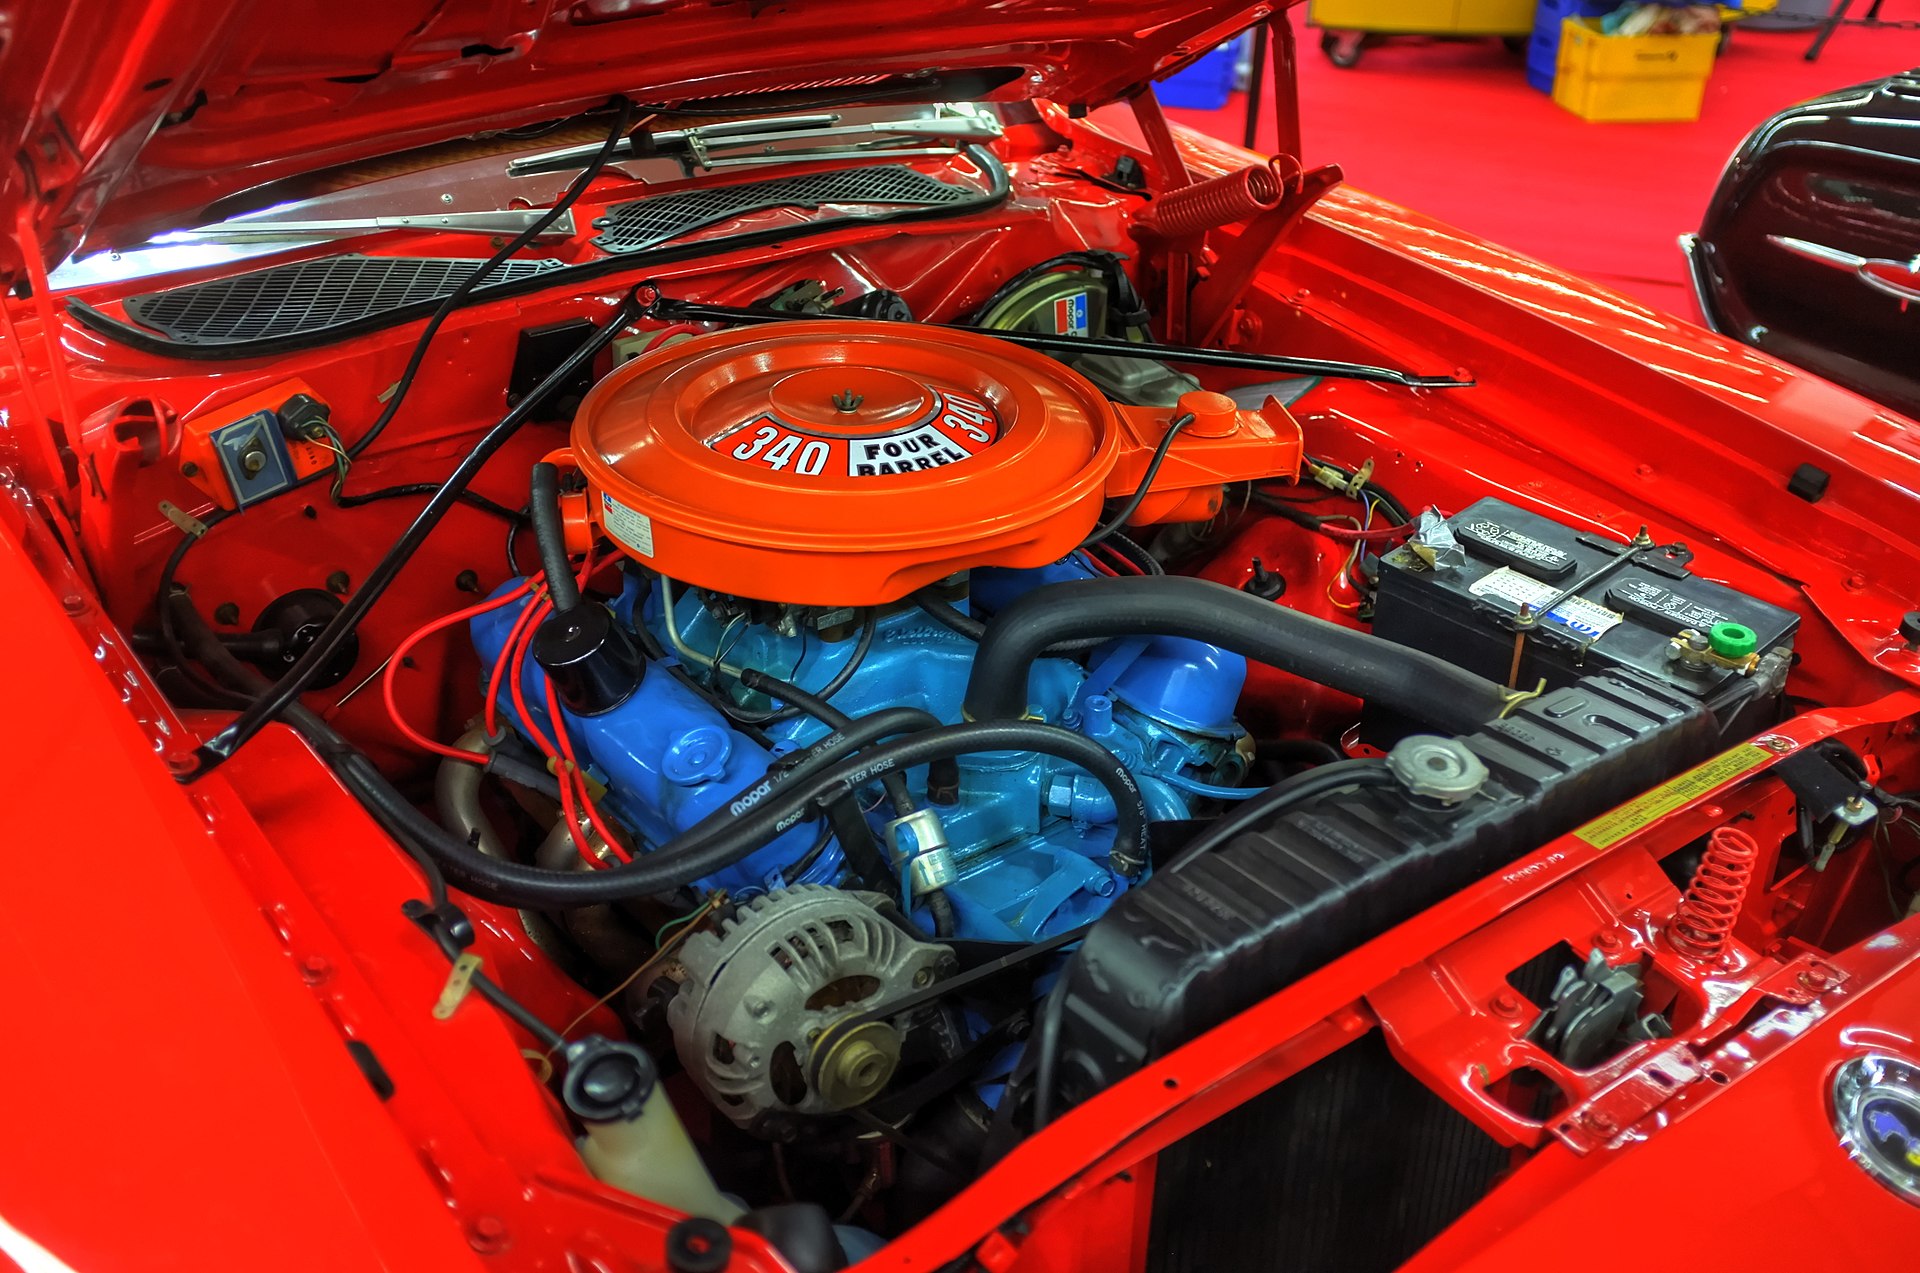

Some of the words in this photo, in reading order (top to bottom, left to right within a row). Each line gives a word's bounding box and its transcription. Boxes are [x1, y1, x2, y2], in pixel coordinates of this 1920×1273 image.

[943, 391, 993, 444] 340
[732, 426, 831, 476] 340
[863, 433, 941, 461] FOUR
[856, 446, 966, 477] BARREL
[822, 732, 846, 750] HOSE
[870, 758, 896, 775] HOSE
[1115, 767, 1137, 793] mopar
[730, 780, 772, 817] mopar
[776, 807, 805, 832] mopar
